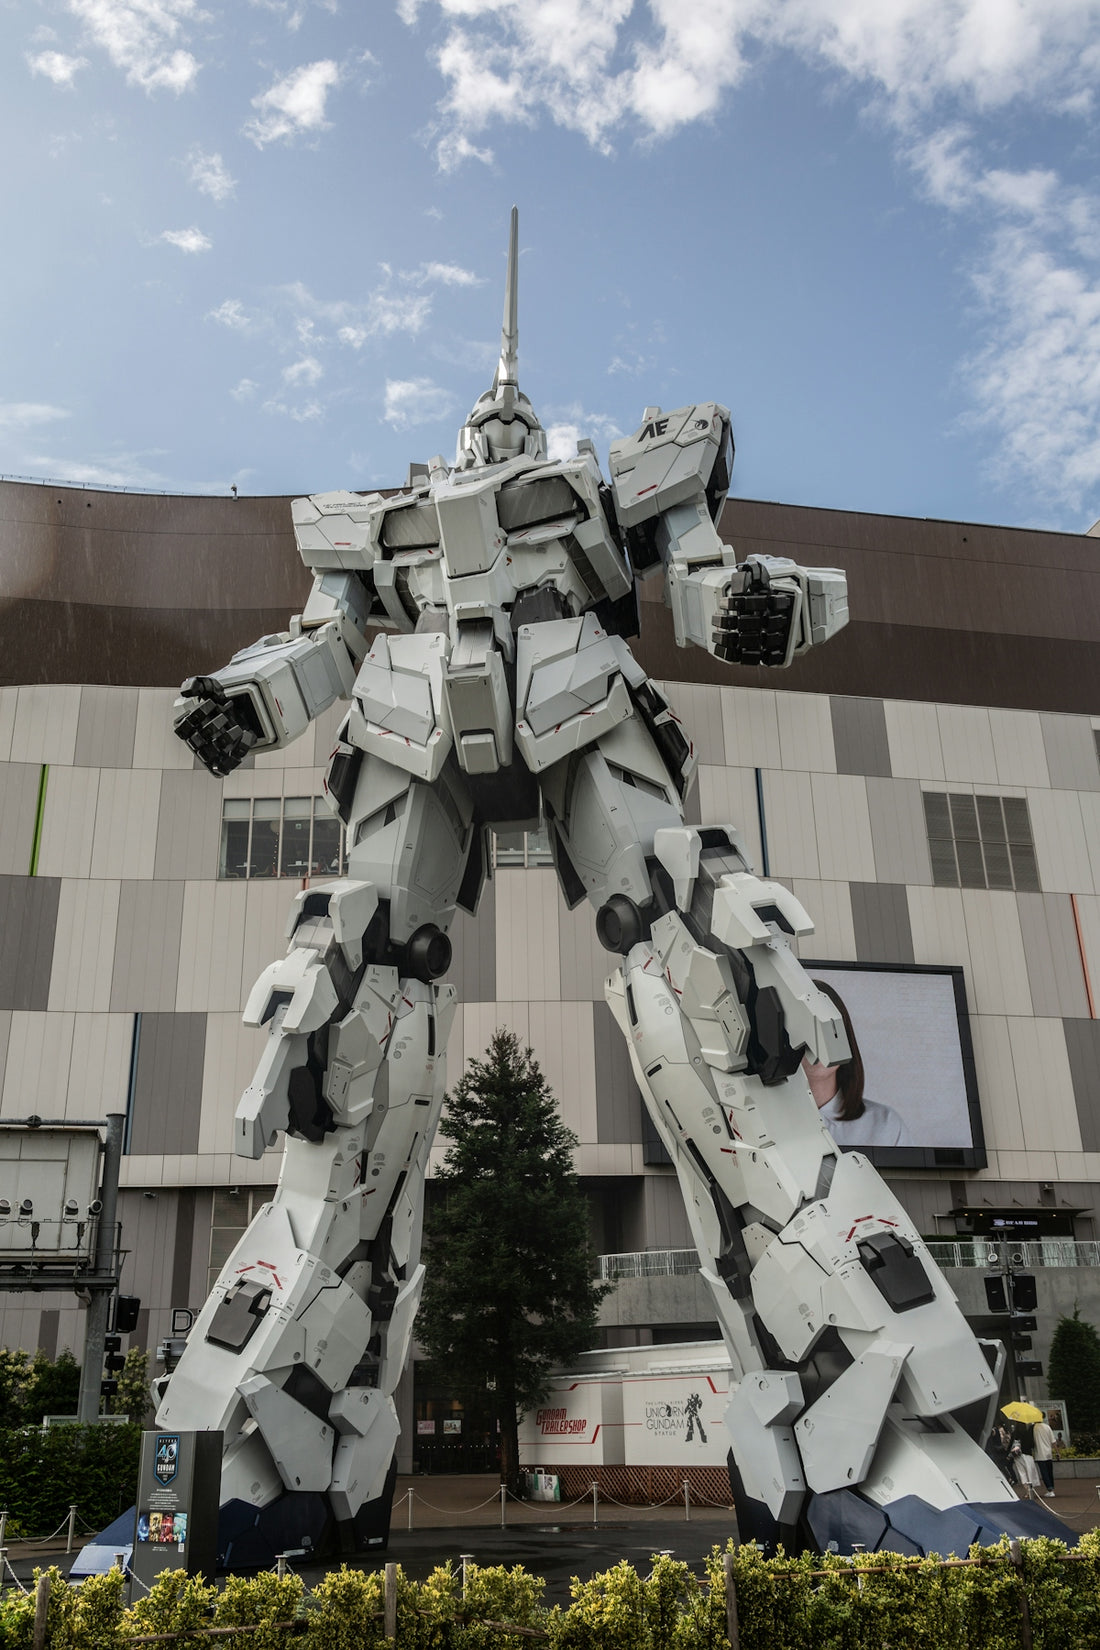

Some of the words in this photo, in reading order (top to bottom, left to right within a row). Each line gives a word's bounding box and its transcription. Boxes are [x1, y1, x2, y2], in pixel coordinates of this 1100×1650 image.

[637, 418, 669, 443] AE
[536, 1408, 567, 1426] GUNDAM
[646, 1418, 685, 1430] GUNDAM
